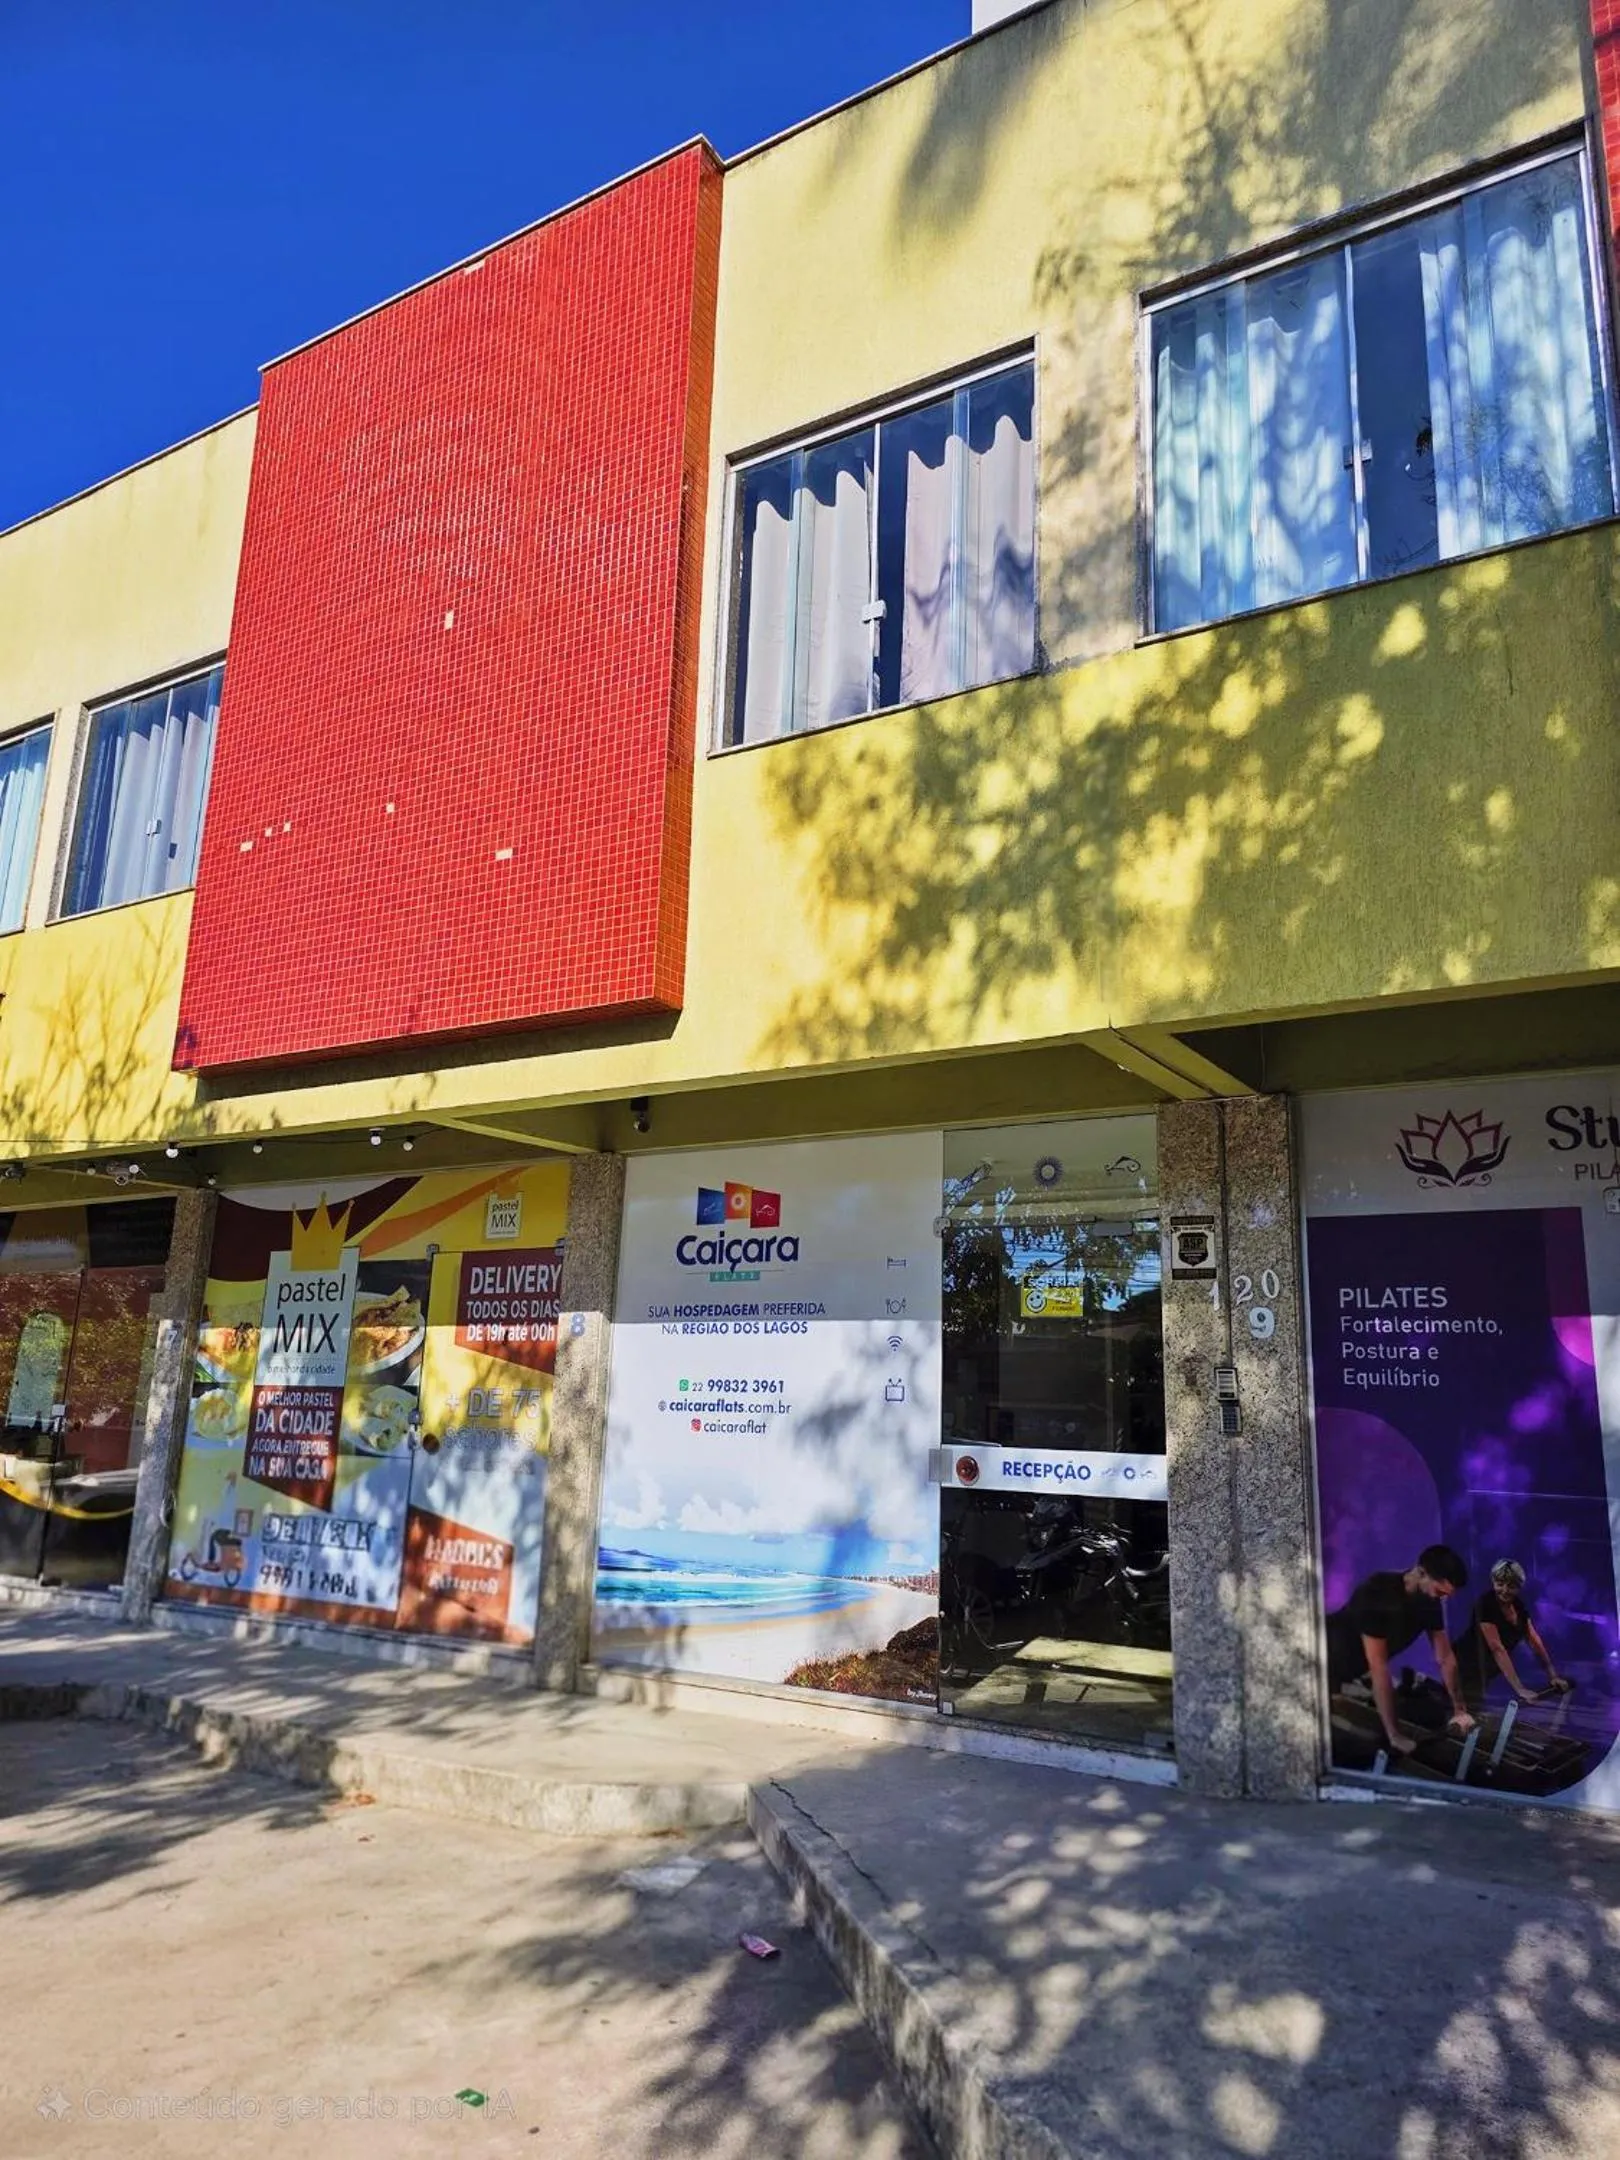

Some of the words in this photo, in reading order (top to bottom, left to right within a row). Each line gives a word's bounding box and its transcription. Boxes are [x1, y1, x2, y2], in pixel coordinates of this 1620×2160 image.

[491, 1200, 519, 1213] pastel
[491, 1213, 517, 1228] MIX
[676, 1230, 800, 1274] Caiçara
[470, 1263, 563, 1295] DELIVERY
[277, 1273, 346, 1310] pastel
[1339, 1286, 1448, 1309] PILATES
[466, 1301, 508, 1319] TODOS
[510, 1301, 529, 1318] OS
[530, 1300, 561, 1318] DIAS
[648, 1305, 670, 1318] SUA
[673, 1303, 760, 1317] HOSPEDAGEM
[763, 1302, 826, 1316] PREFERIDA
[273, 1313, 340, 1353] MIX
[466, 1325, 484, 1341] DE
[486, 1322, 505, 1341] 19h
[507, 1322, 528, 1341] até
[531, 1323, 555, 1341] 00h
[570, 1313, 586, 1337] 8
[661, 1324, 679, 1335] NA
[733, 1322, 760, 1335] DOS
[764, 1321, 808, 1334] LAGOS
[1249, 1306, 1275, 1339] 9
[1340, 1316, 1503, 1335] Fortalecimento,
[167, 1329, 178, 1350] 7
[1342, 1342, 1420, 1360] Postura
[1428, 1347, 1439, 1360] e
[692, 1382, 703, 1392] 22
[707, 1379, 748, 1393] 99832
[752, 1380, 784, 1393] 3961
[1343, 1367, 1440, 1390] Equilíbrio
[258, 1392, 266, 1406] O
[266, 1392, 302, 1406] MELHOR
[303, 1392, 334, 1407] PASTEL
[468, 1387, 504, 1417] DE
[511, 1387, 541, 1418] 75
[669, 1399, 792, 1414] caicaraflats.com.br
[255, 1408, 276, 1433] DA
[279, 1408, 335, 1435] CIDADE
[703, 1419, 767, 1434] caicaraflat
[248, 1455, 266, 1476] NA
[1002, 1460, 1092, 1484] RECEPÇÃO
